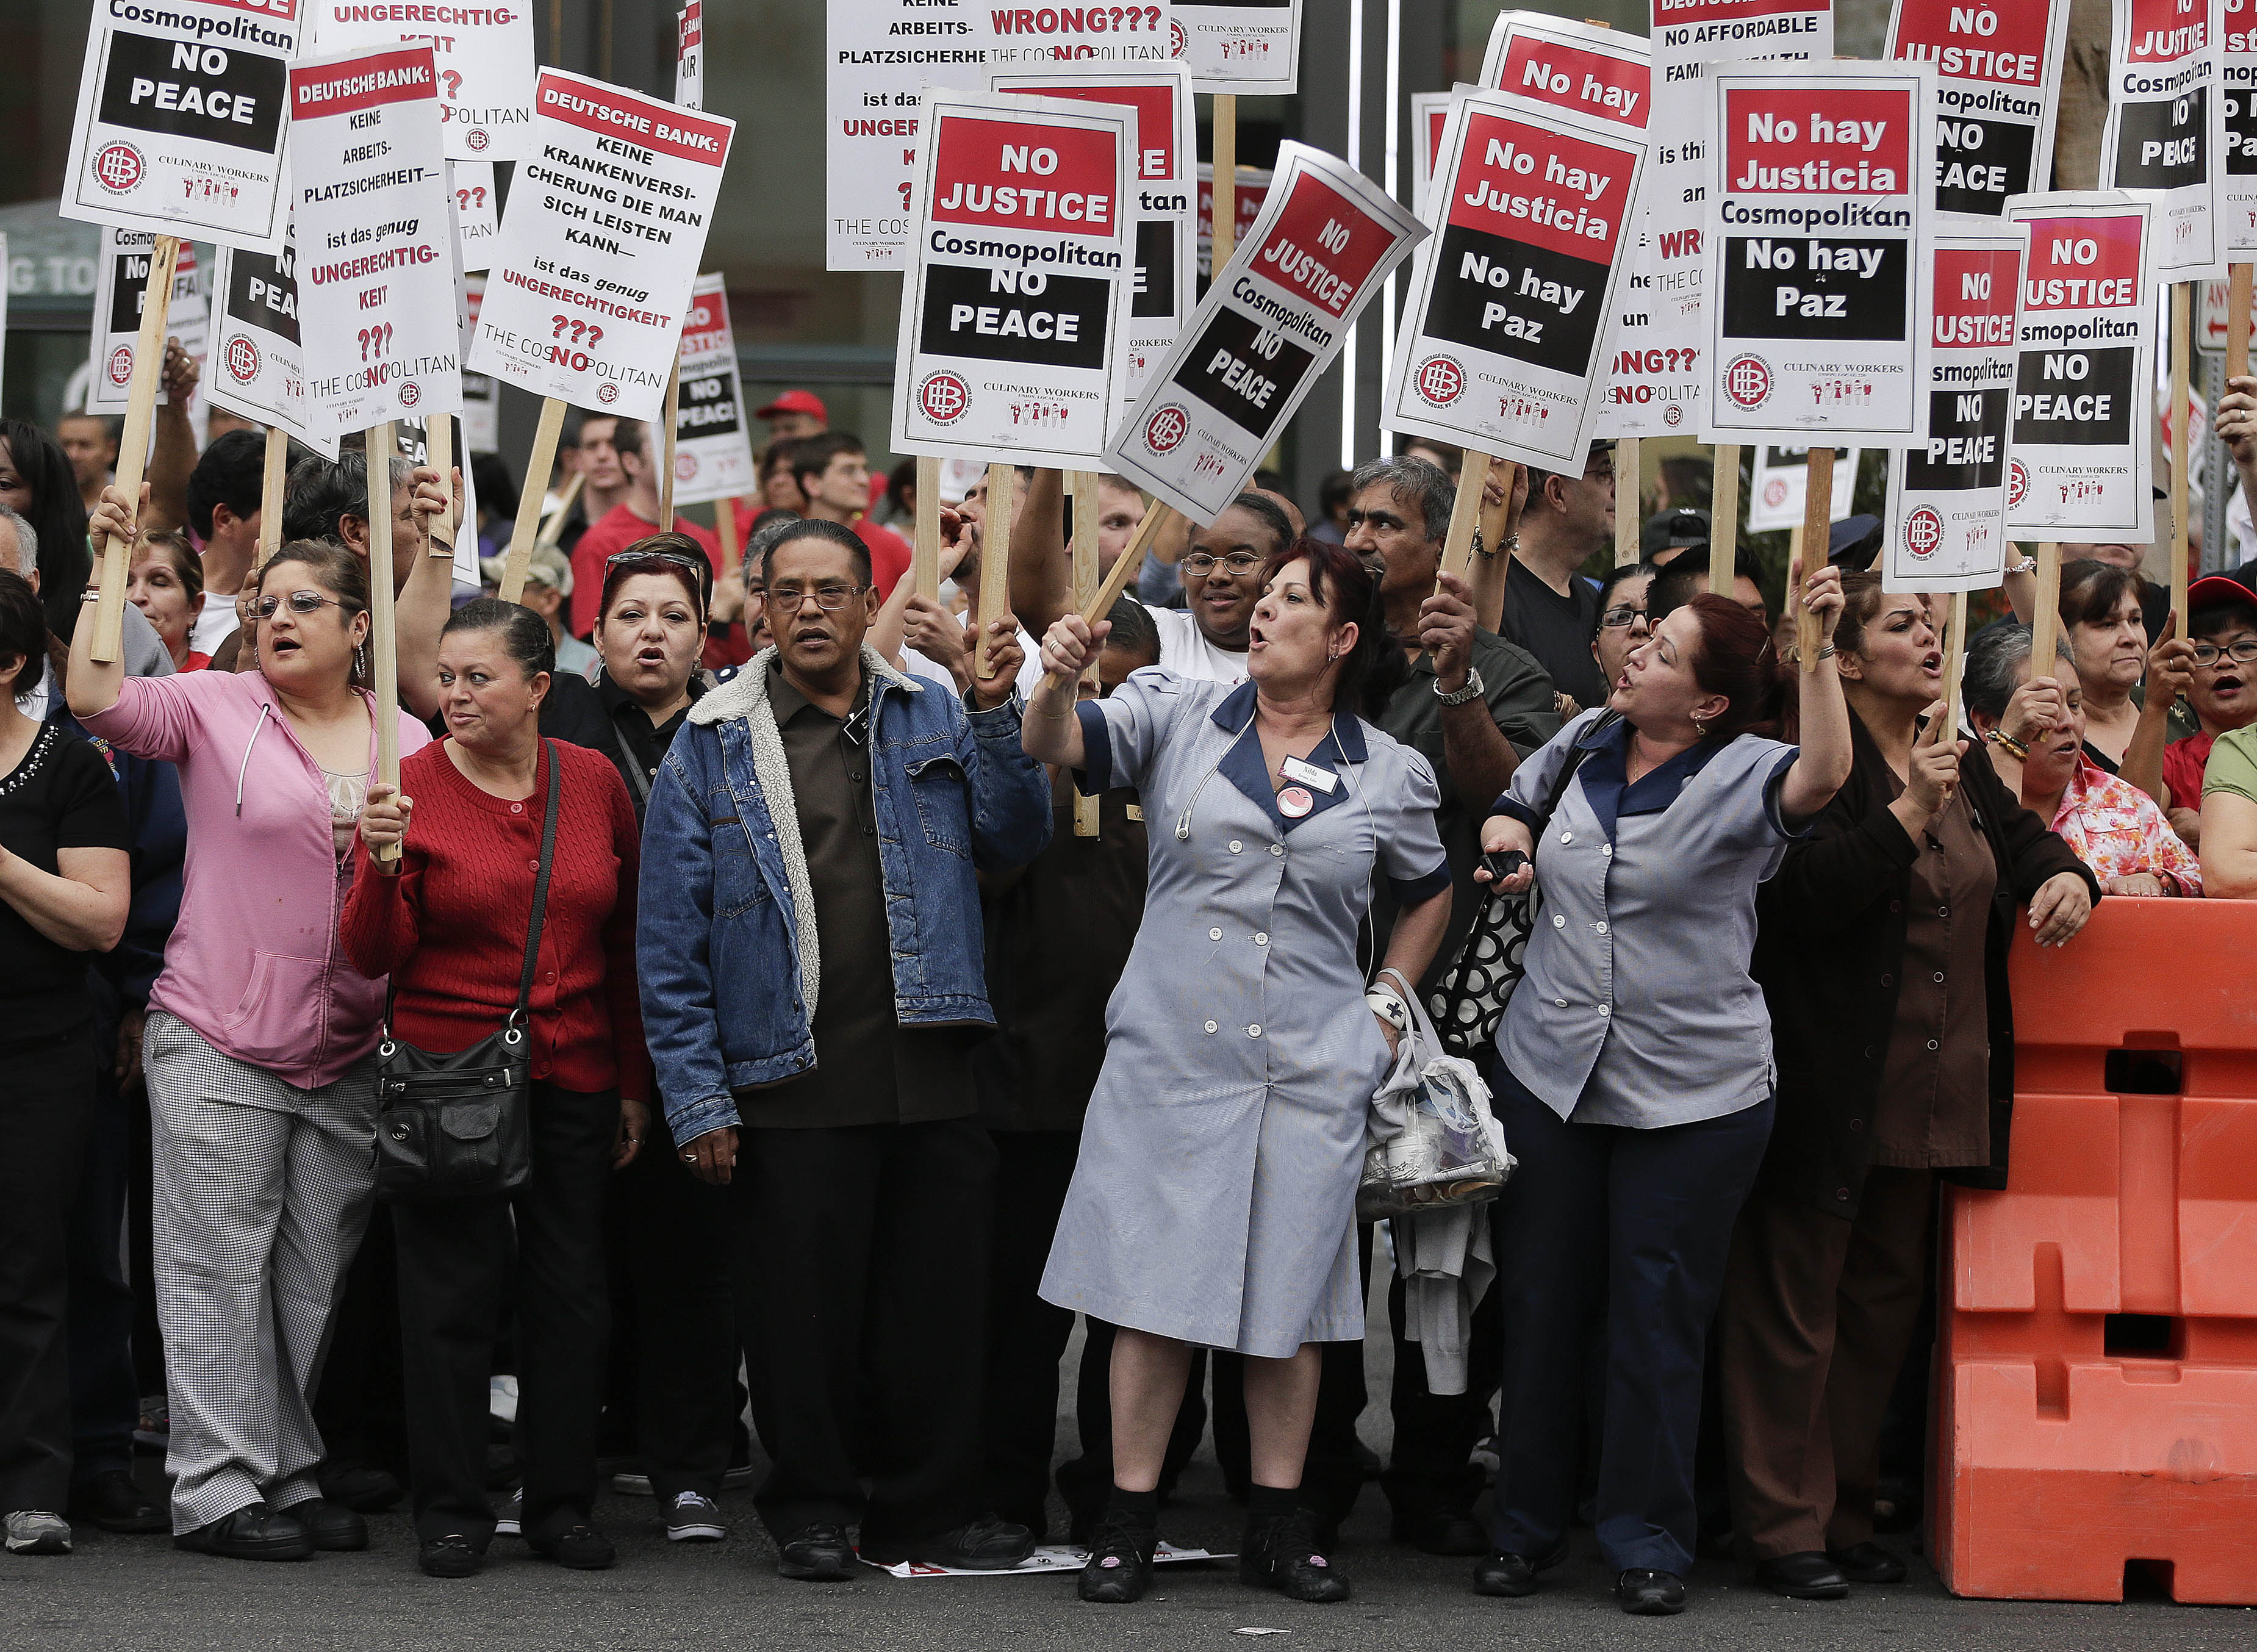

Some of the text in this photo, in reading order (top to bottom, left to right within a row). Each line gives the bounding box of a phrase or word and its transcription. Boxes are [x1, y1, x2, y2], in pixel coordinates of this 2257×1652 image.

[109, 0, 293, 50] Cosmopolitan
[334, 5, 518, 26] UNGERECHTIG-
[888, 21, 974, 36] ARBEITS-
[990, 5, 1162, 35] WRONG???
[1197, 24, 1289, 34] CULINARY WORKERS
[1949, 7, 1998, 36] NO
[1665, 16, 1818, 47] NO AFFORDABLE
[2134, 22, 2205, 56] JUSTICE
[171, 42, 229, 76] NO
[991, 49, 1016, 60] THE
[298, 65, 430, 104] DEUTSCHE BANK:
[863, 92, 888, 107] ist
[1522, 59, 1640, 117] No hay
[129, 77, 256, 124] PEACE
[1937, 88, 2041, 117] opolitan
[2172, 99, 2189, 127] NO
[350, 110, 381, 131] KEINE
[543, 88, 719, 152] DEUTSCHE BANK:
[1748, 113, 1887, 151] No hay
[1936, 121, 1984, 150] NO
[343, 141, 392, 165] ARBEITS-
[595, 137, 655, 165] KEINE
[1000, 144, 1059, 176] NO
[1659, 140, 1706, 165] is thi
[2140, 136, 2196, 167] PEACE
[159, 156, 214, 171] CULINARY
[217, 165, 270, 183] WORKERS
[543, 144, 696, 201] KRANKENVERSI-
[1484, 138, 1611, 202] No hay
[1736, 160, 1895, 191] Justicia
[1935, 161, 2008, 193] EACE
[527, 164, 702, 227] CHERUNG DIE MAN
[939, 182, 1109, 223] JUSTICE
[1464, 180, 1609, 241] Justicia
[543, 195, 672, 244] SICH LEISTEN
[834, 218, 872, 234] THE
[1721, 200, 1910, 233] Cosmopolitan
[327, 218, 419, 250] ist das genug
[930, 230, 1122, 269] Cosmopolitan
[1316, 218, 1350, 255] NO
[126, 256, 148, 279] No
[312, 245, 440, 286] UNGERECHTIG-
[1746, 239, 1885, 279] No hay
[2051, 239, 2098, 265] NO
[533, 256, 650, 303] ist das genug
[989, 268, 1048, 296] NO
[1263, 239, 1353, 312] JUSTICE
[1460, 251, 1585, 315] No hay
[1657, 272, 1685, 292] THE
[1962, 273, 1991, 301] NO
[359, 285, 388, 310] KEIT
[503, 268, 671, 328] UNGERECHTIGKEIT
[1776, 286, 1847, 317] Paz
[2026, 278, 2133, 306] USTICE
[949, 304, 1080, 342] PEACE
[1232, 276, 1332, 348] Cosmopolitan
[1481, 301, 1544, 343] Paz
[357, 322, 393, 362] ???
[484, 323, 517, 348] THE
[551, 314, 605, 349] ???
[1130, 339, 1173, 348] ORKERS
[1250, 326, 1283, 361] NO
[1936, 315, 2012, 343] USTICE
[2021, 317, 2138, 347] smopolitan
[1205, 348, 1277, 409] PEACE
[1784, 363, 1903, 373] CULINARY WORKERS
[1932, 356, 2012, 389] smopolitan
[2044, 354, 2090, 380] NO
[310, 377, 340, 398] THE
[689, 378, 722, 401] NO
[983, 382, 1099, 400] CULINARY WORKERS
[1478, 372, 1527, 391] CULINARY
[1529, 386, 1578, 406] WORKERS
[1956, 394, 1982, 422] NO
[2014, 395, 2111, 421] PEACE
[1197, 428, 1221, 451] CULINARY
[1221, 444, 1248, 466] WORKERS
[1928, 436, 1995, 465] PEACE
[2039, 465, 2083, 474] CULINARY
[1303, 766, 1318, 777] Nilda
